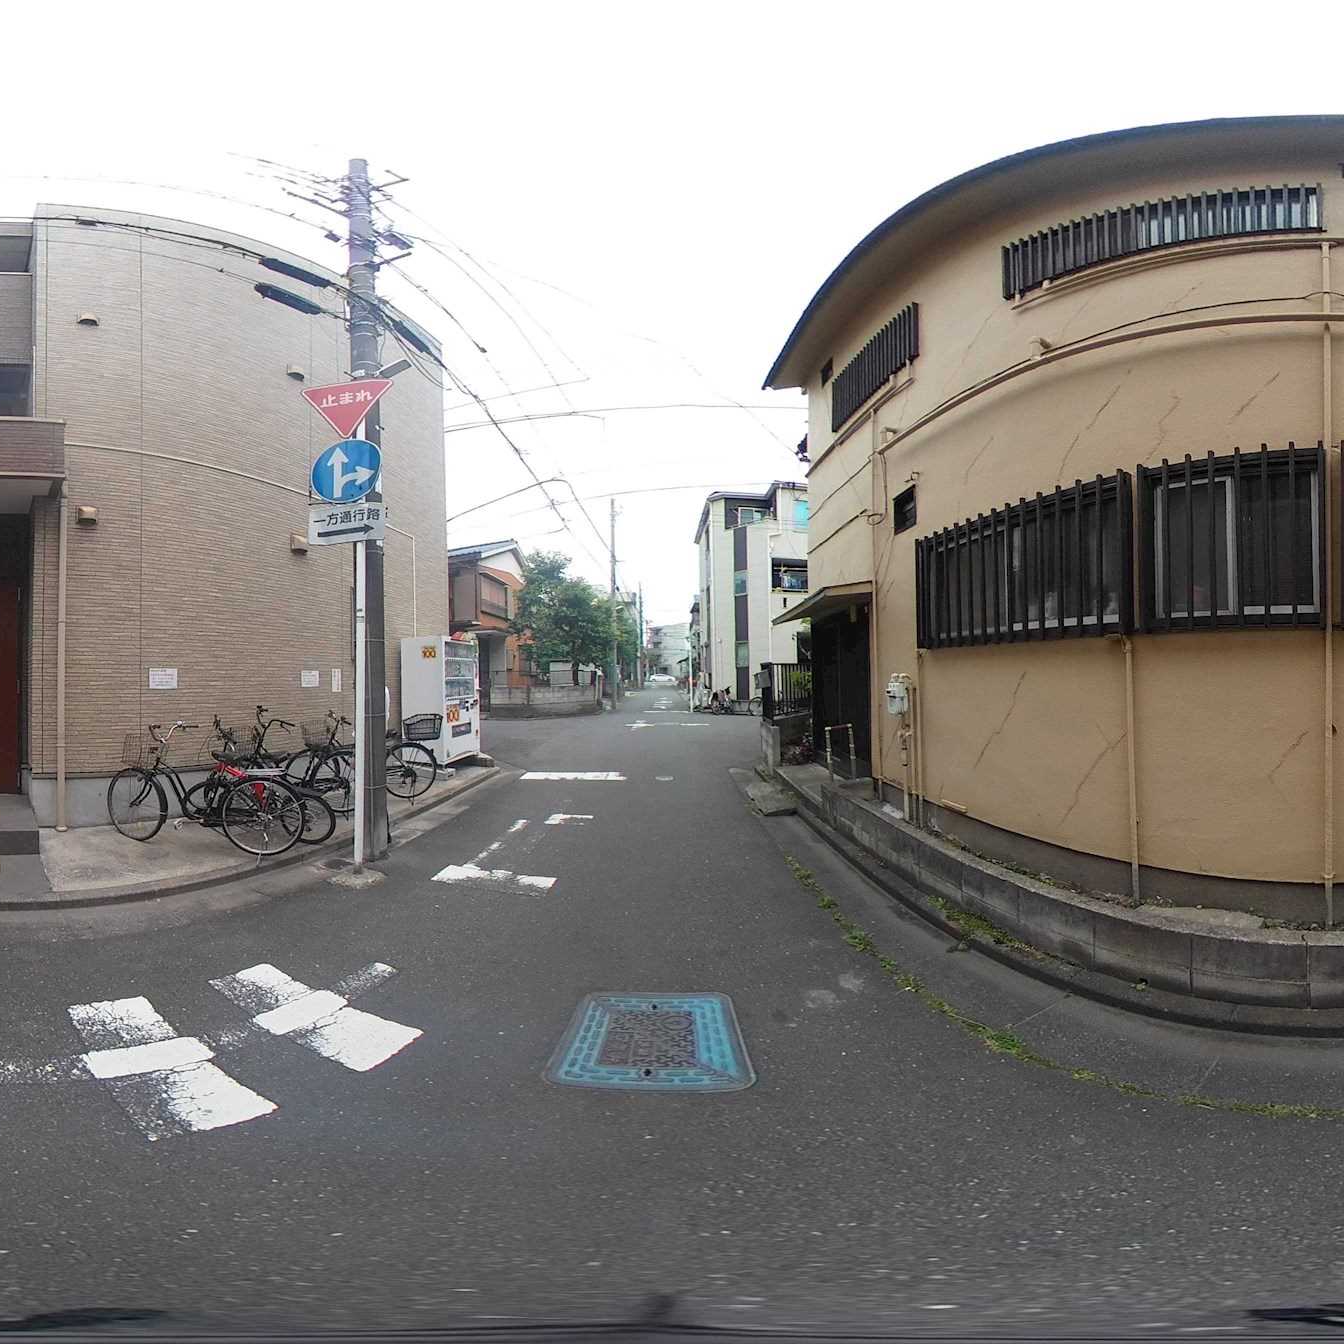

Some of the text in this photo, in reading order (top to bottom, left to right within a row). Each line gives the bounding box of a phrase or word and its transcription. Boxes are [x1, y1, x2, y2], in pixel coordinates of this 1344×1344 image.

[320, 390, 373, 408] 止まれ
[313, 507, 380, 527] 一方通行路
